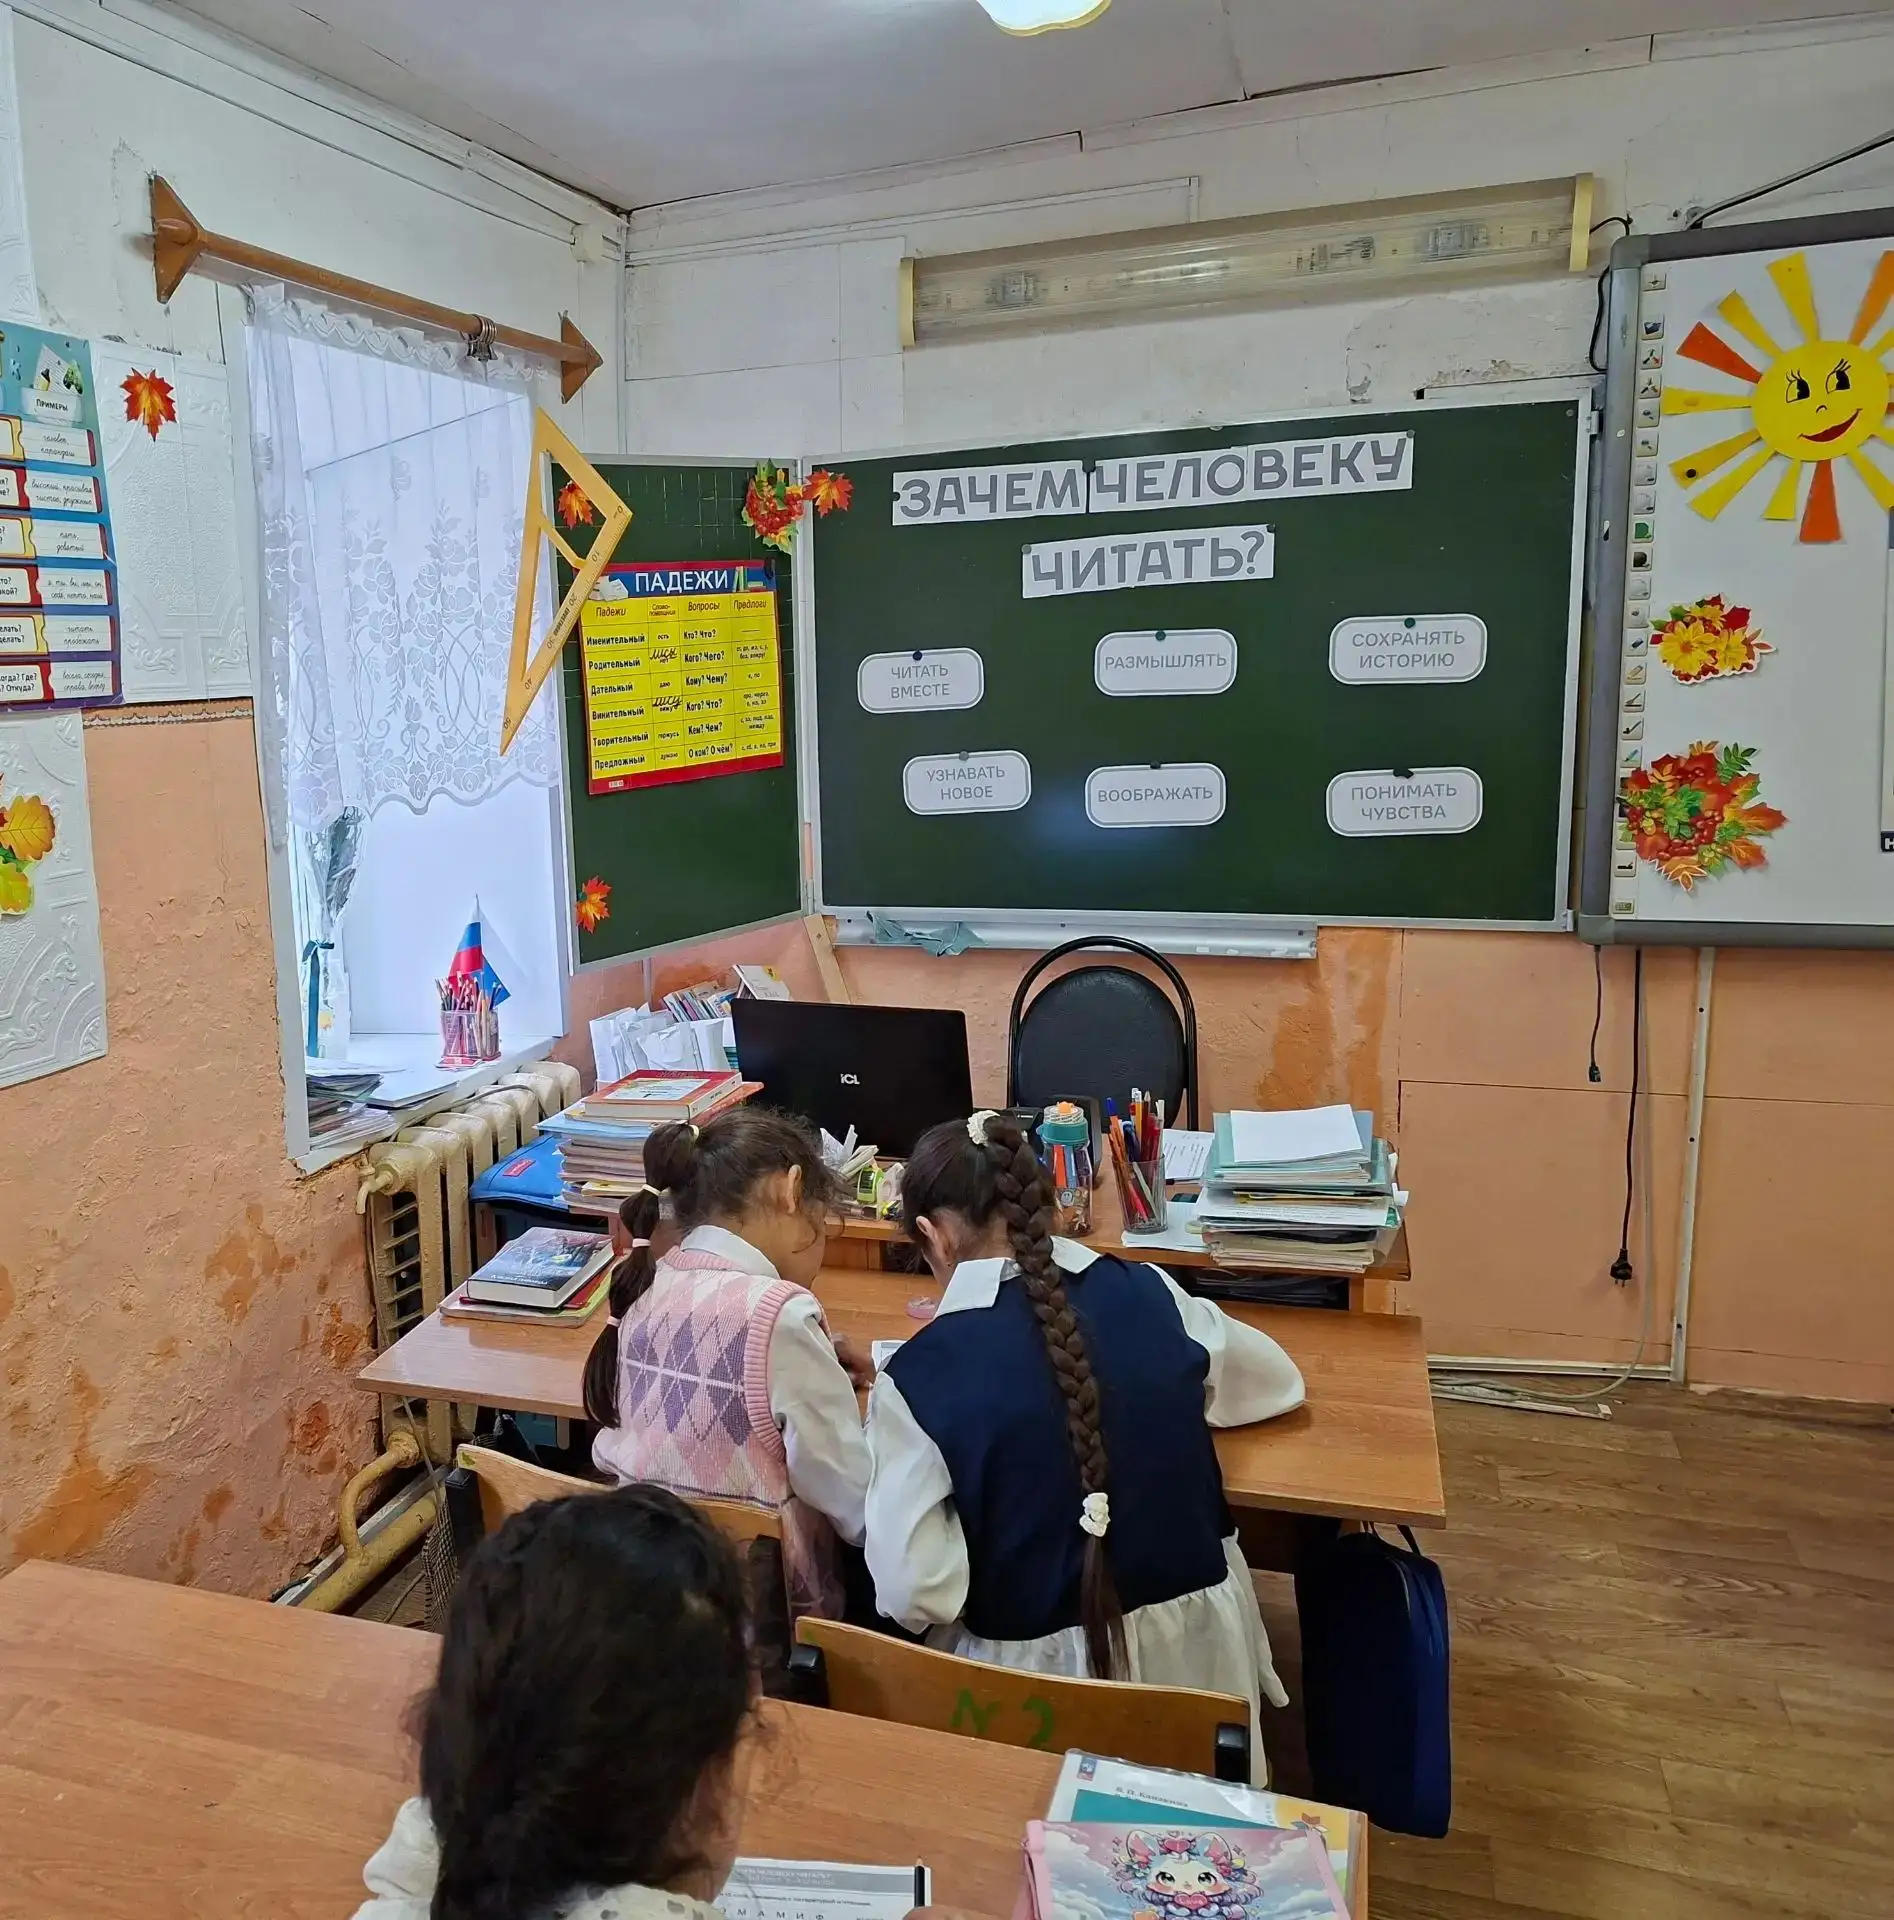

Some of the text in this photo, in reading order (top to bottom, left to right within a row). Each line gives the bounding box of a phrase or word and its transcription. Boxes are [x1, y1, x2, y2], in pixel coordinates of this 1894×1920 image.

[36, 399, 69, 412] ПРИМЕРЫ
[900, 438, 1407, 518] ЗАЧЕМ ЧЕЛОВЕКУ
[592, 552, 600, 562] 10
[1031, 530, 1265, 591] ЧИТАТЬ?
[635, 569, 728, 594] ПАДЕЖИ
[568, 593, 577, 606] 20
[687, 601, 720, 613] Вопросы
[733, 599, 767, 612] Предлоги
[596, 606, 627, 618] Падежи
[586, 633, 645, 646] Именительный
[683, 628, 717, 640] Кто? Что?
[1352, 631, 1466, 648] СОХРАНЯТЬ
[588, 657, 641, 671] Родительный
[684, 650, 725, 664] Кого? Чего?
[1104, 653, 1227, 670] РАЗМЫШЛЯТЬ
[1359, 652, 1455, 669] ИСТОРИЮ
[21, 672, 37, 681] Где?
[891, 664, 949, 680] ЧИТАТЬ
[685, 673, 728, 687] Кому? Чему?
[6, 684, 35, 693] Откуда?
[591, 681, 633, 696] Дательный
[890, 683, 950, 700] ВМЕСТЕ
[686, 698, 723, 711] Кого? Что?
[592, 705, 645, 720] Винительный
[658, 732, 680, 740] горжусь
[688, 722, 723, 735] Кем? Чем?
[593, 731, 649, 747] Творительный
[660, 752, 679, 760] думаю
[688, 742, 733, 758] О ком? О чём?
[594, 754, 645, 770] Предложный
[926, 765, 1006, 782] УЗНАВАТЬ
[939, 785, 994, 801] НОВОЕ
[1098, 786, 1213, 803] ВООБРАЖАТЬ
[1351, 783, 1458, 801] ПОНИМАТЬ
[1361, 804, 1447, 821] ЧУВСТВА
